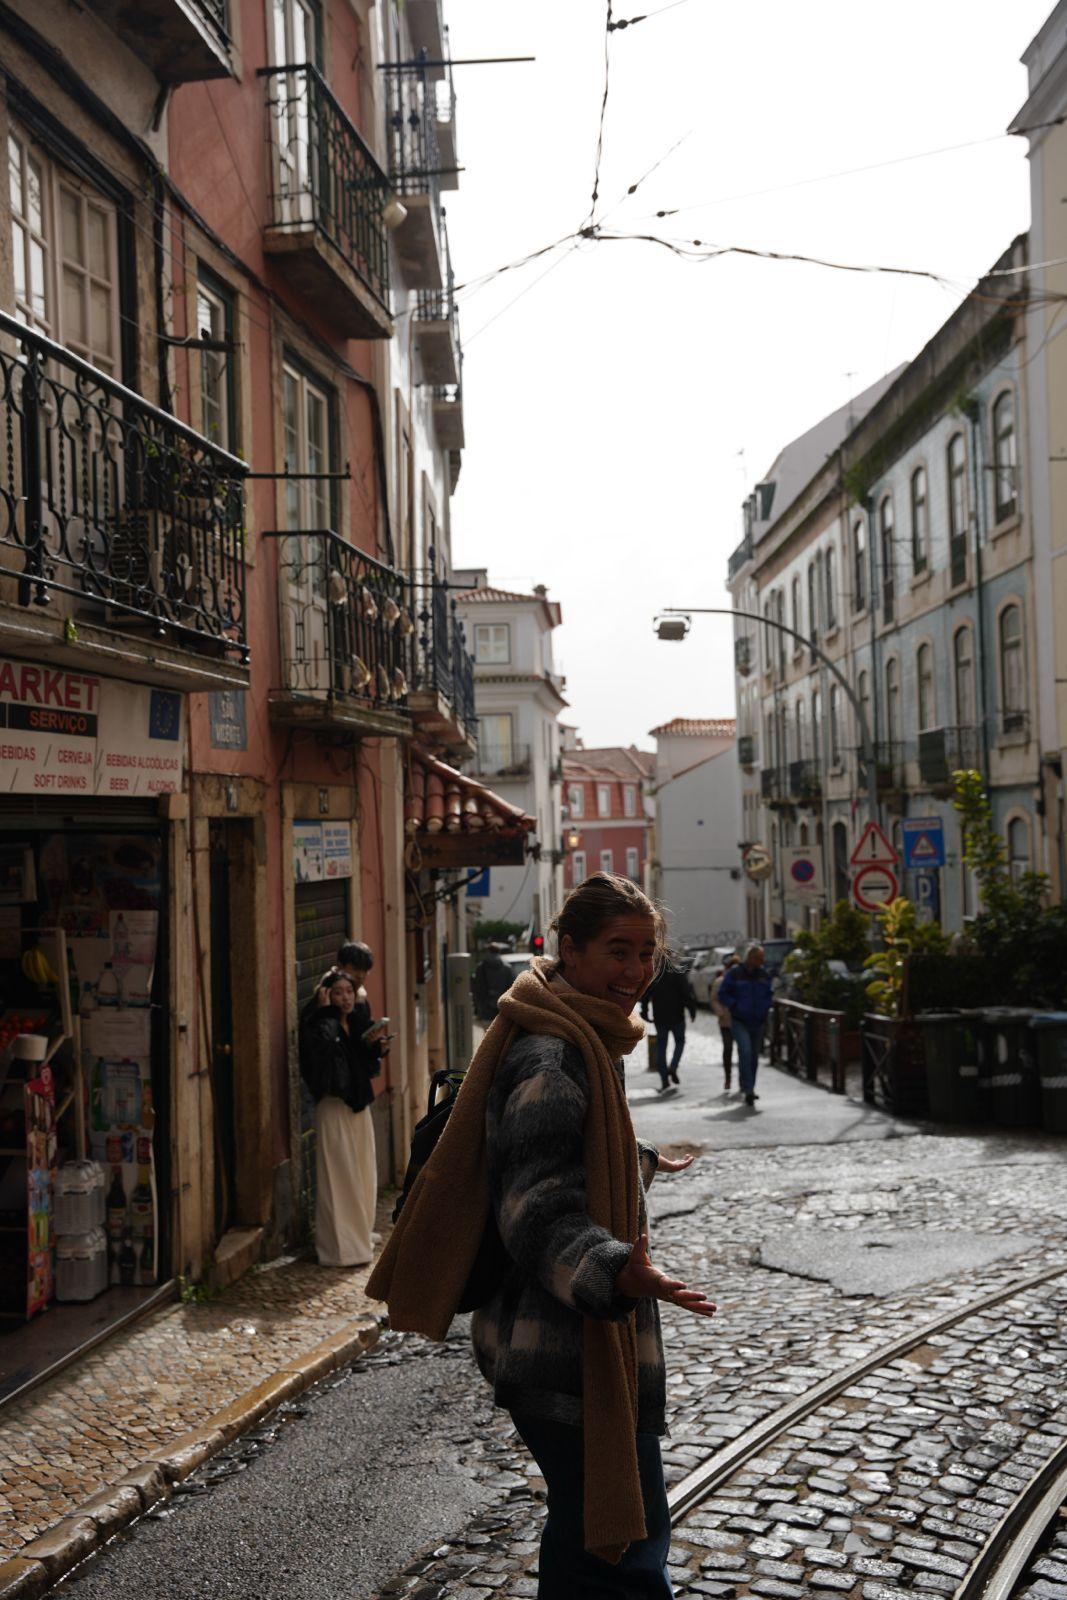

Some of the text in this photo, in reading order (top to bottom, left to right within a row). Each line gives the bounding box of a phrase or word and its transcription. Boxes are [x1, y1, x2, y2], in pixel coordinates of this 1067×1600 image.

[29, 710, 88, 733] SERVIÇO
[57, 749, 92, 765] CERVEJA
[106, 753, 136, 767] BEBIDAS
[34, 774, 177, 793] SOFT DRINKS BEER ALCOHOL
